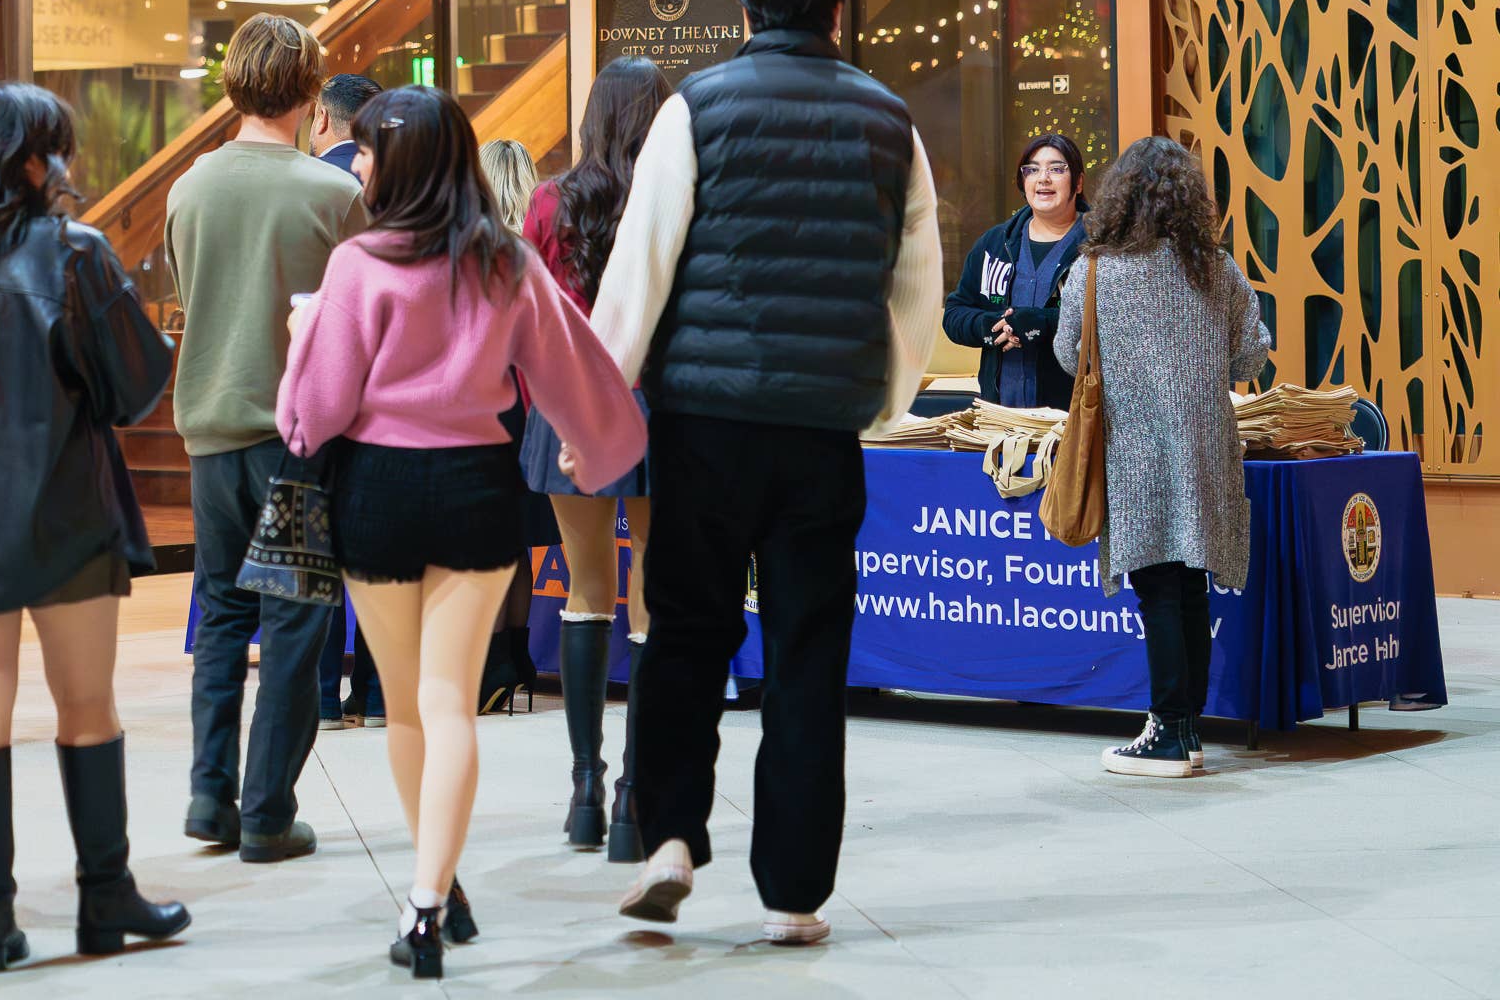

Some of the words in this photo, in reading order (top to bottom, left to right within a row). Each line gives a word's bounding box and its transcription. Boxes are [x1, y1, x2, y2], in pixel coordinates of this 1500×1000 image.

[600, 27, 668, 42] DOWNEY
[672, 24, 741, 40] THEATRE
[621, 46, 647, 56] CITY
[651, 45, 665, 55] OF
[669, 43, 719, 55] DOWNEY
[1018, 81, 1051, 91] ELEVATOR
[912, 506, 1033, 540] JANICE
[855, 548, 994, 587] pervisor,
[1325, 643, 1369, 671] Jance
